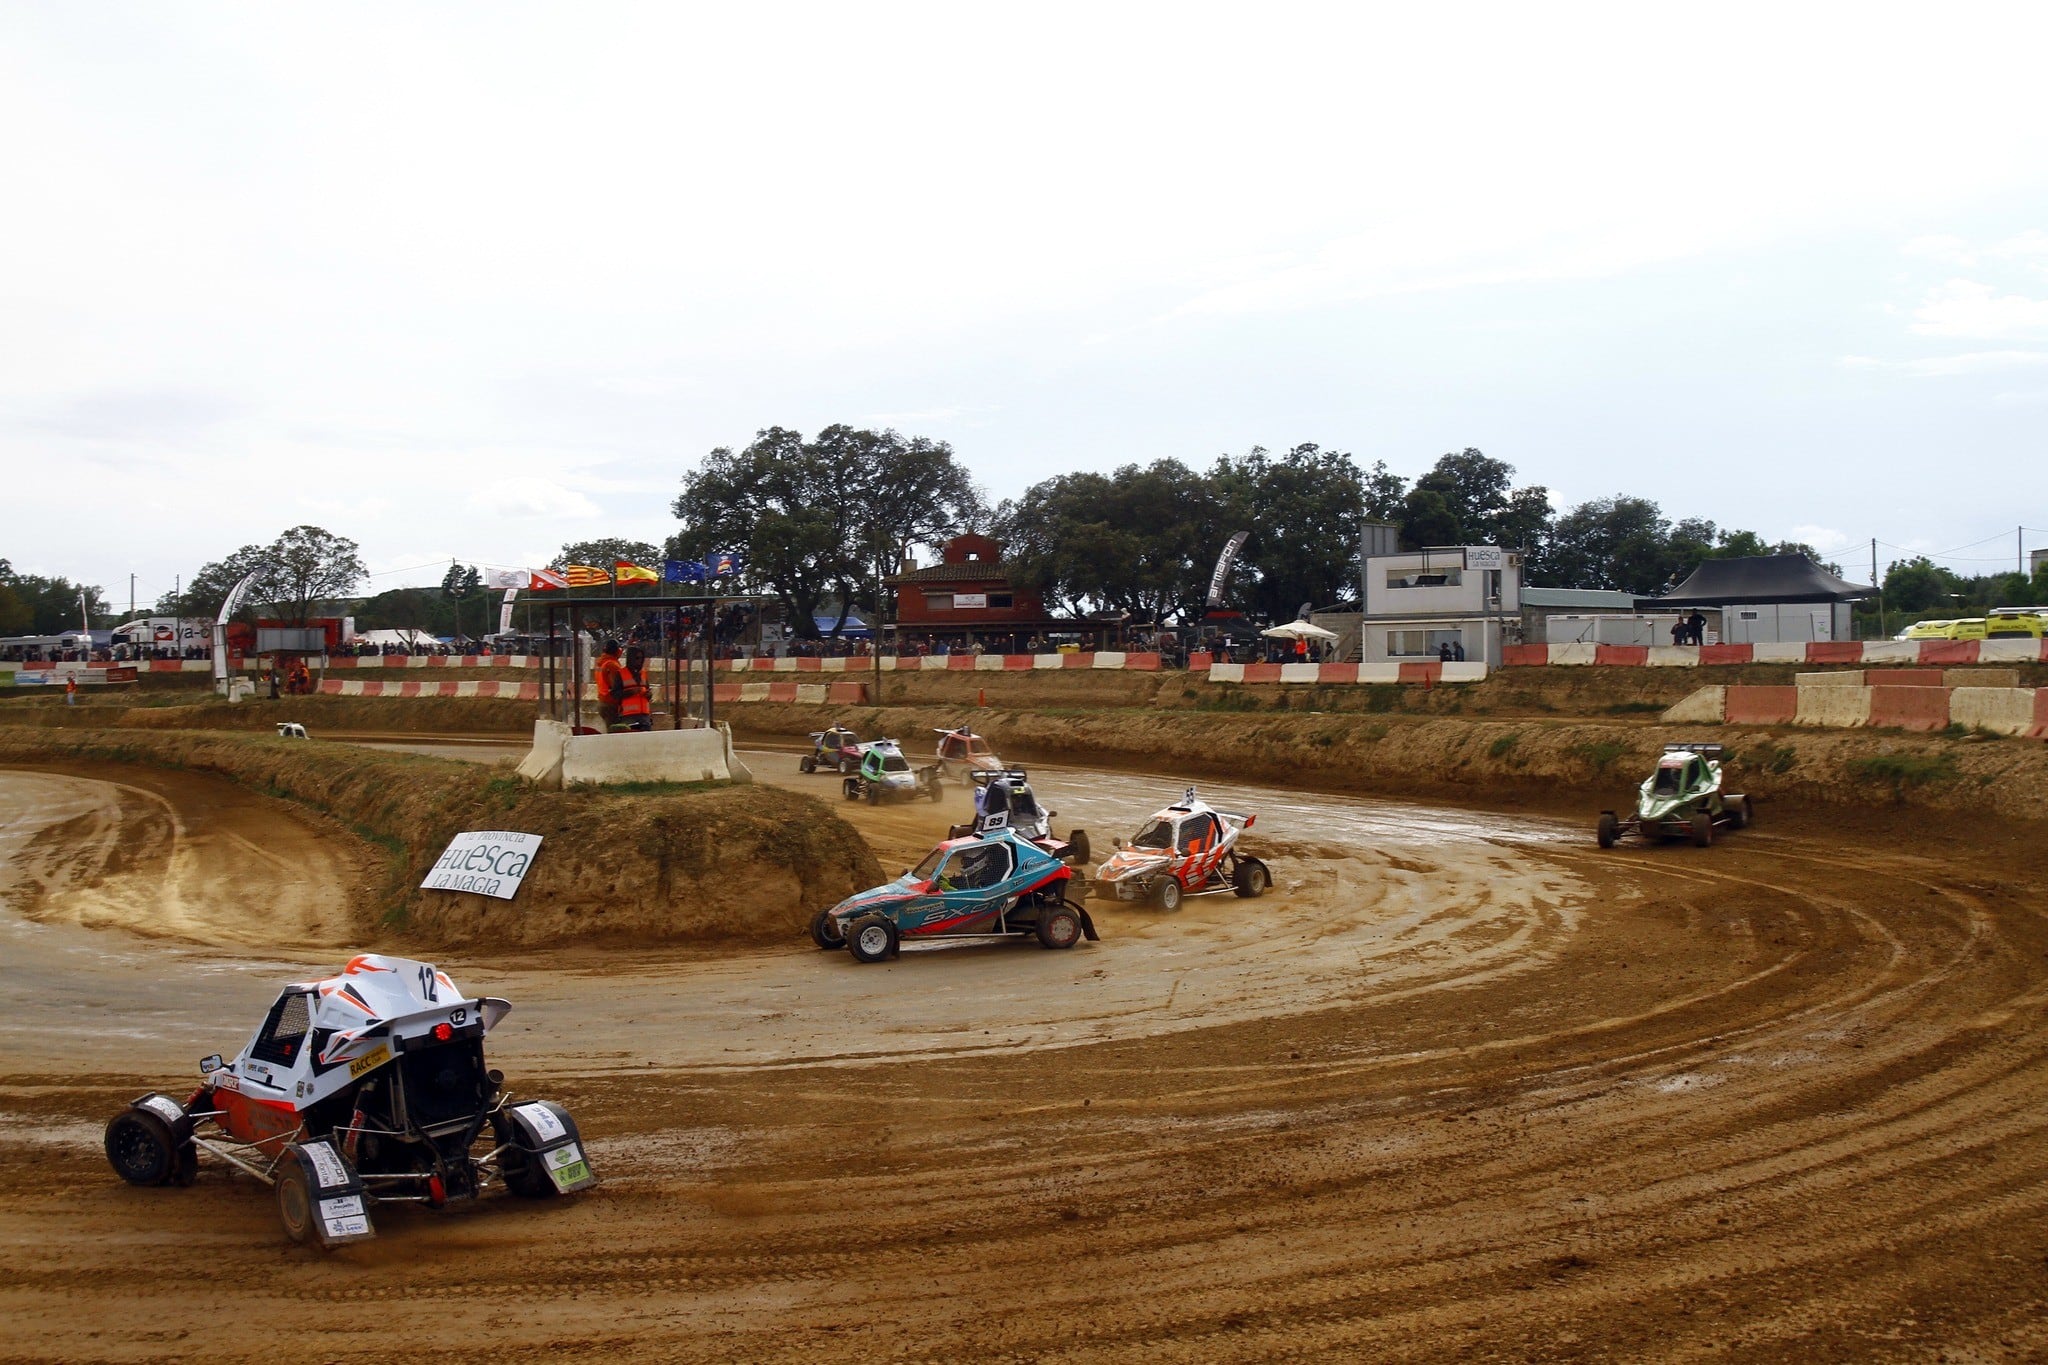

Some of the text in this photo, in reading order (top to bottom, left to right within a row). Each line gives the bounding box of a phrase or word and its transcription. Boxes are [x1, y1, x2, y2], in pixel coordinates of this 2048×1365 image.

[1468, 550, 1500, 561] Huesca
[1209, 539, 1237, 598] armafon
[988, 816, 1003, 827] 89
[434, 844, 528, 879] Huesca
[418, 965, 437, 1002] 12
[450, 1011, 465, 1023] 12
[350, 1056, 371, 1076] RACC
